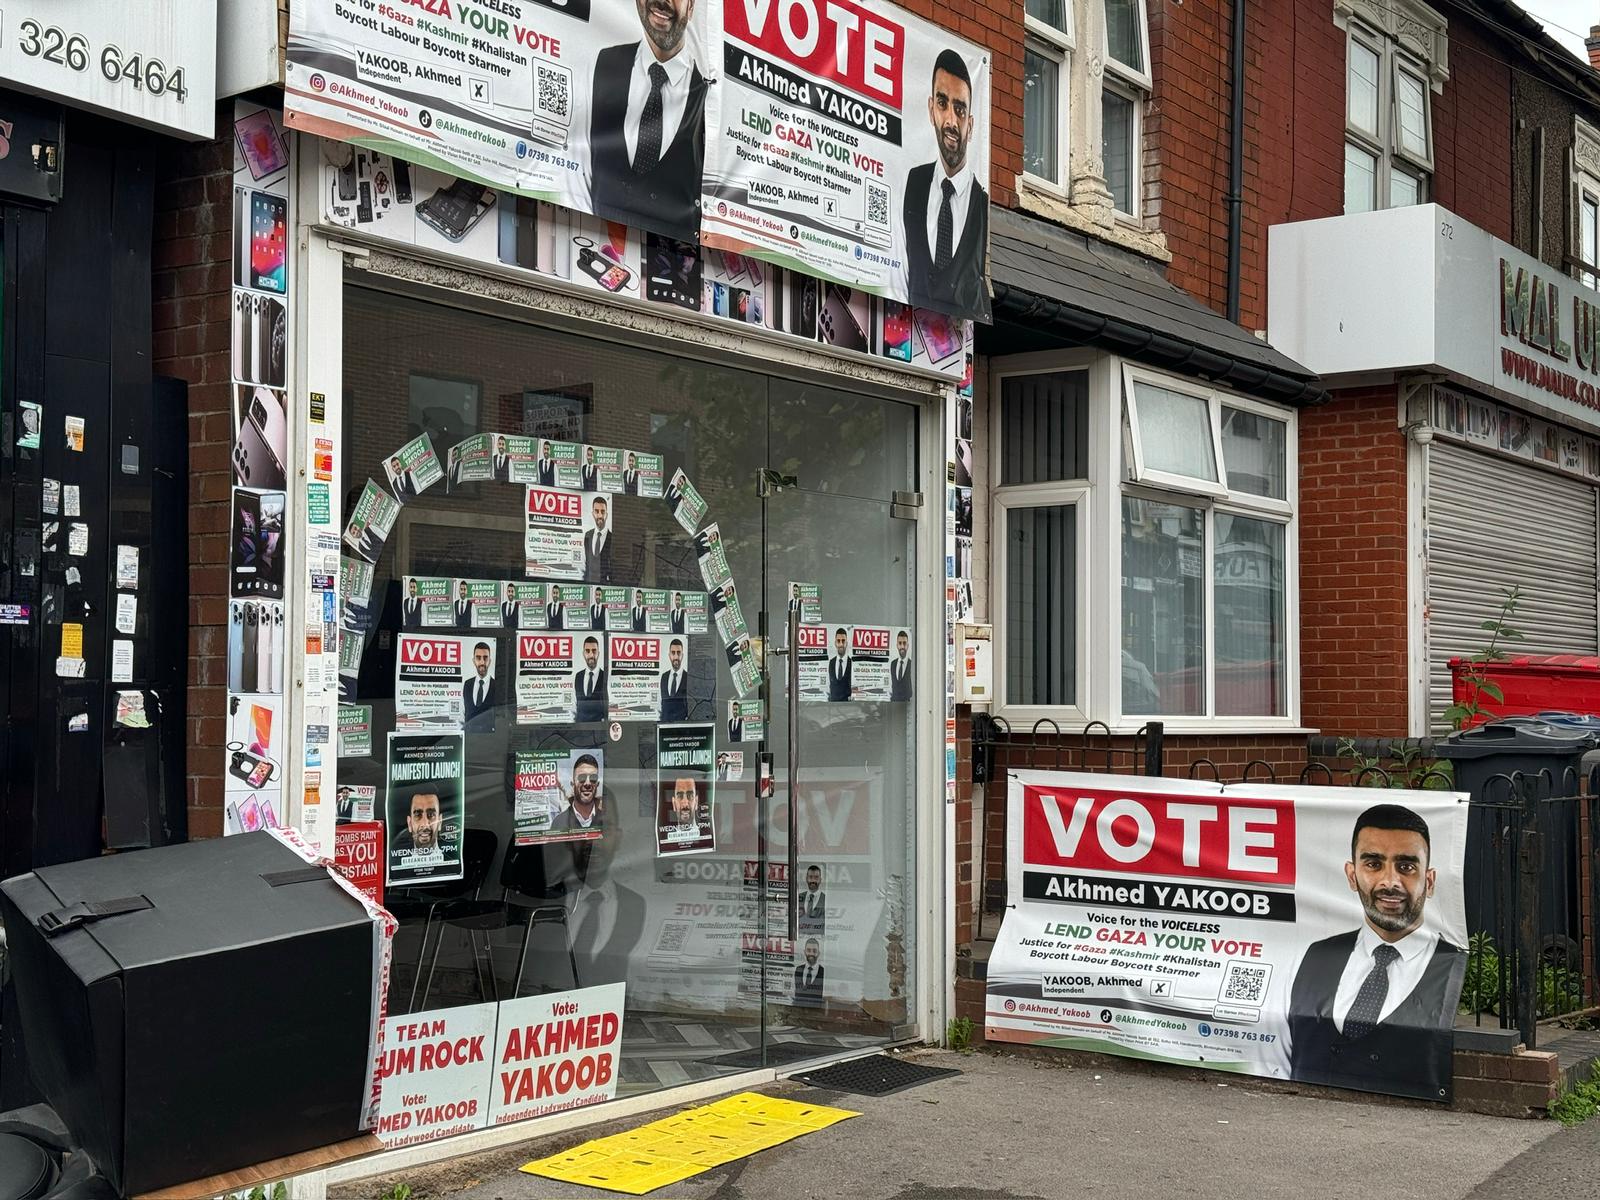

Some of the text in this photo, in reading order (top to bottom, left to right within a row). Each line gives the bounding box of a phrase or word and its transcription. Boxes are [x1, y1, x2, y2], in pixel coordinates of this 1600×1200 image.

[335, 5, 512, 78] Boycott Labour Boycott Starmer
[378, 4, 415, 27] #Gaza
[417, 19, 469, 46] #Kashmir
[472, 38, 528, 66] #Khalistan
[457, 3, 509, 40] YOUR
[513, 24, 561, 58] VOTE
[742, 0, 896, 96] VOTE
[19, 19, 187, 104] 326 6464
[357, 50, 461, 88] YAKOOB, Akhmed
[358, 65, 402, 84] Independent
[329, 82, 409, 118] @Akhmed_Yakoob
[739, 57, 888, 136] Akhmed YAKOOB
[435, 119, 507, 150] @AkhmedYakoob
[769, 104, 859, 148] Voice for the VOICELESS
[741, 108, 884, 178] LEND GAZA YOUR VOTE
[527, 148, 580, 172] 07398 763 867
[726, 126, 862, 185] Justice for #Gaza #Kashmir #Khalistan
[736, 145, 852, 196] Boycott Labour Boycott Starmer
[749, 181, 819, 206] YAKOOB, Akhmed
[1441, 222, 1454, 240] 272
[1574, 296, 1600, 375] U
[533, 492, 579, 514] VOTE
[421, 580, 446, 588] Akhmed
[471, 583, 494, 591] Akhmed
[472, 590, 494, 598] YAKOOB
[524, 639, 570, 657] VOTE
[614, 640, 657, 657] VOTE
[799, 628, 825, 645] OTE
[856, 631, 888, 647] VOTE
[406, 642, 458, 662] VOTE
[520, 762, 556, 774] AKHMED
[660, 750, 712, 767] MANIFESTO LAUNCH
[391, 761, 460, 781] MANIFESTO LAUNCH
[519, 774, 557, 788] YAKOOB
[357, 787, 374, 795] VOTE
[336, 831, 376, 844] BOMBS RAIN
[1039, 794, 1279, 874] VOTE
[336, 842, 376, 863] AS YOU
[391, 847, 438, 857] WEDNESDA
[1045, 877, 1270, 916] Akhmed YAKOOB
[1087, 912, 1220, 934] Voice for the VOICELESS
[1044, 922, 1263, 958] LEND GAZA YOUR VOTE
[1019, 937, 1221, 969] Justice for #Gaza #Kashmir #Khalistan
[1030, 950, 1200, 979] Boycott Labour Boycott Starmer
[1043, 975, 1143, 988] YAKOOB, Akhmed
[1044, 987, 1084, 995] Independent
[1154, 983, 1164, 994] X
[552, 1002, 579, 1017] Vote:
[396, 1020, 445, 1041] TEAM
[1018, 1002, 1276, 1044] @Akhmed_Yakoob @AkhmedYakoob 07398 763 867
[502, 1012, 619, 1064] AKHMED
[382, 1035, 485, 1079] UM ROCK
[501, 1052, 613, 1106] YAKOOB
[402, 1094, 427, 1108] Vote:
[495, 1092, 608, 1125] Independent Ladywood Candidate
[380, 1099, 478, 1134] MED YAKOOB
[394, 1131, 435, 1148] Ladywood
[436, 1122, 475, 1141] Candidate
